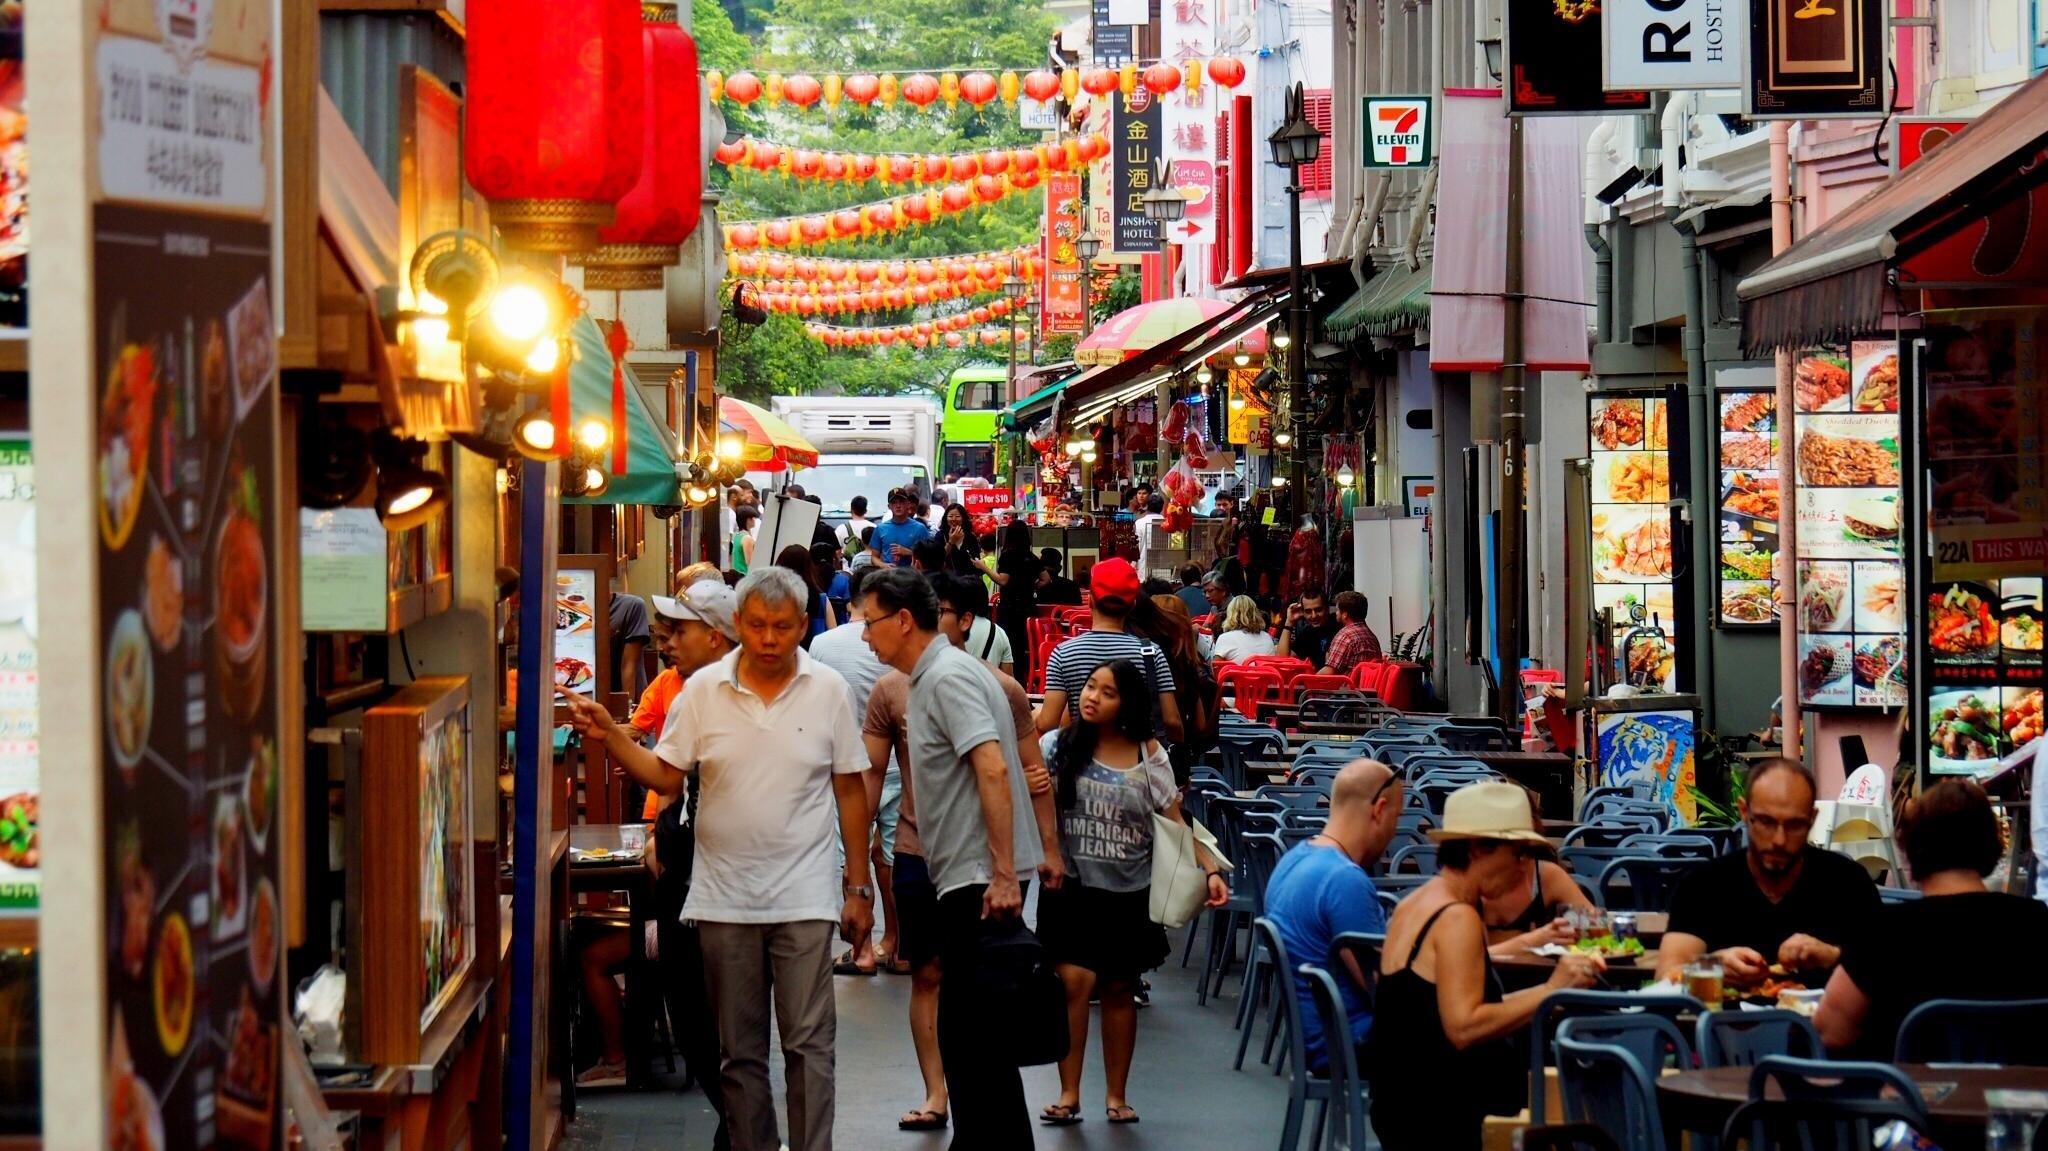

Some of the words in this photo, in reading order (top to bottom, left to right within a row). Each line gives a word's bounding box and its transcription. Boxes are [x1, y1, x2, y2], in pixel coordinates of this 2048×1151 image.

[1643, 0, 1691, 63] R
[1706, 0, 1723, 63] HOST
[1126, 120, 1149, 212] 金山酒店
[1119, 217, 1158, 226] JINSHAN
[1123, 229, 1154, 239] HOTEL
[1504, 438, 1513, 477] 16
[979, 494, 984, 502] 3
[985, 493, 994, 502] for
[1938, 541, 1970, 564] 22A
[1977, 541, 2013, 559] THIS
[1085, 799, 1123, 822] LOVE
[1064, 818, 1143, 845] AMERICAN
[1078, 837, 1126, 860] JEANS
